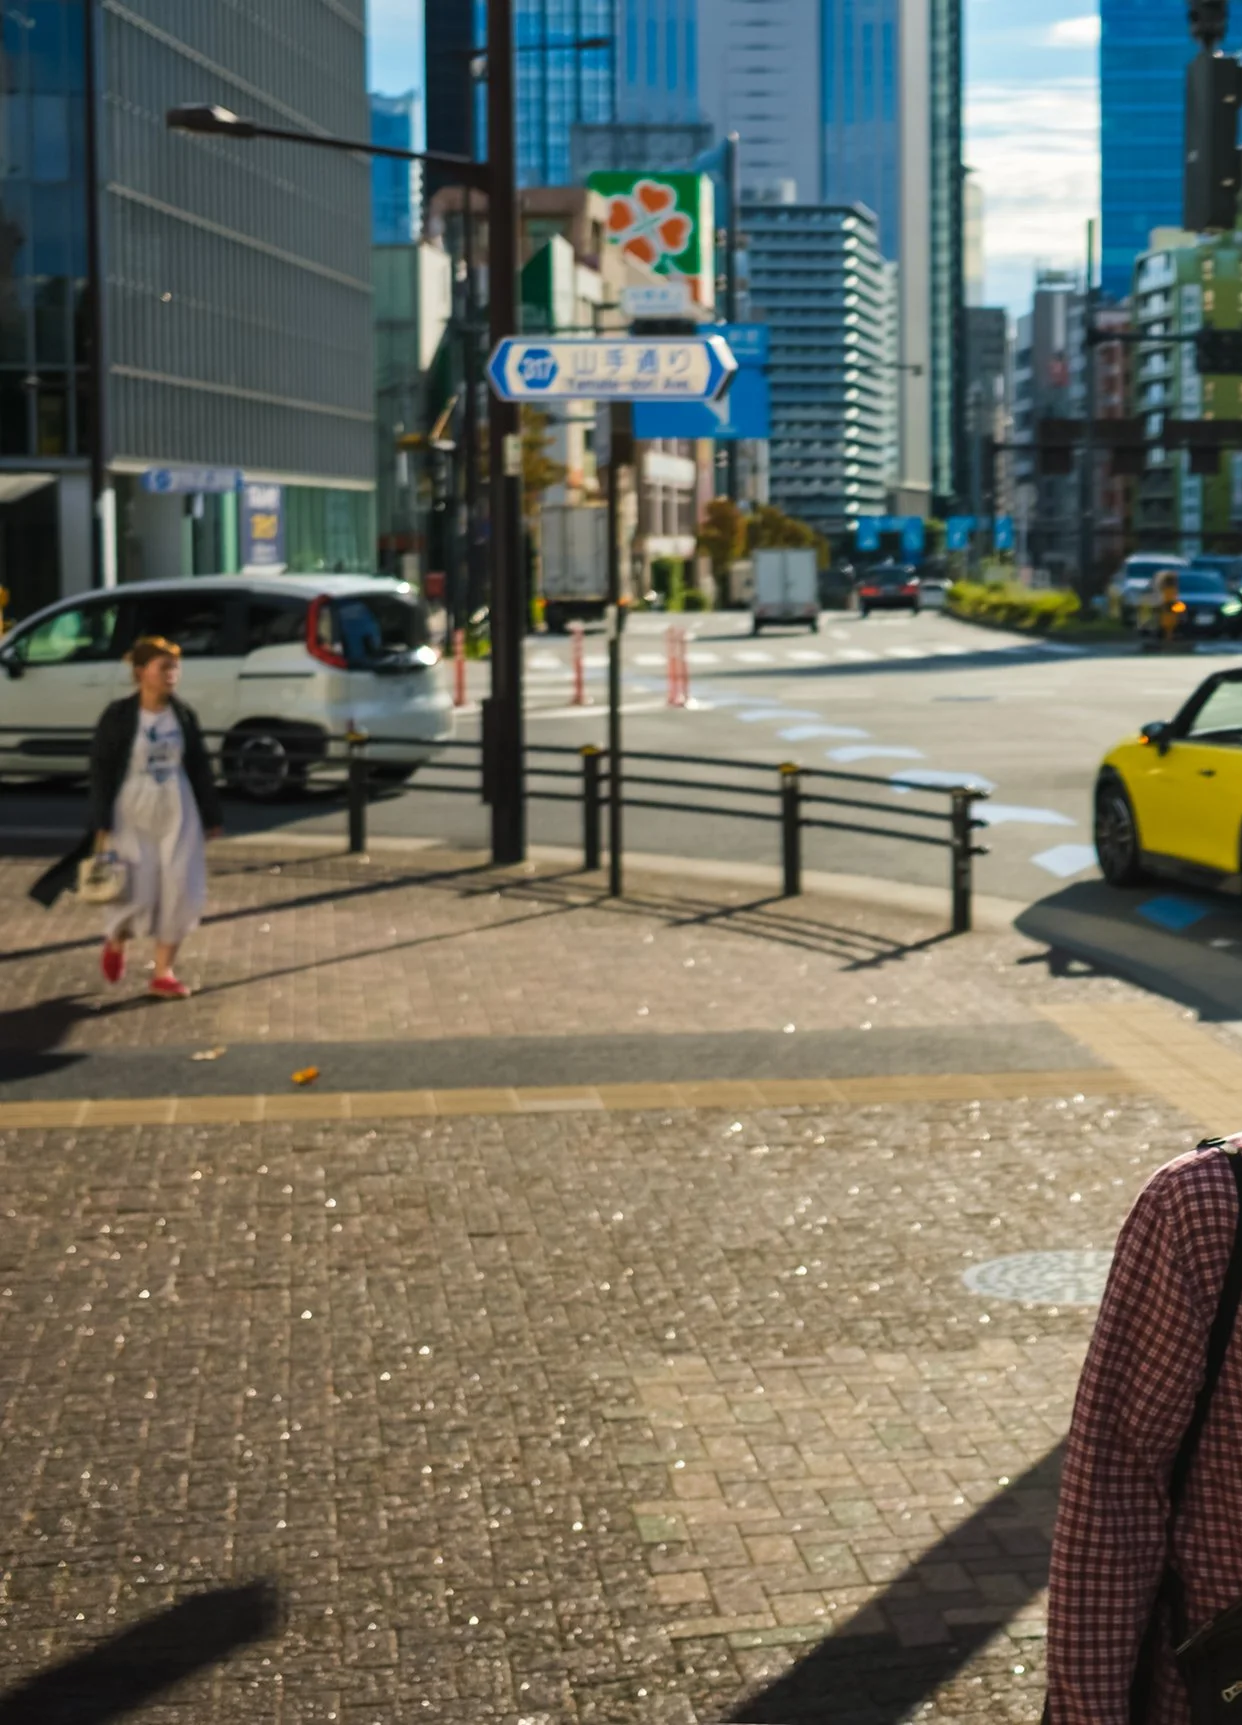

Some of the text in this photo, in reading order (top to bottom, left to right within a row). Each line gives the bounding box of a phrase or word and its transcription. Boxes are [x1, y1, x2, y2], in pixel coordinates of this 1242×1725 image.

[523, 348, 691, 380] 317 山手通り
